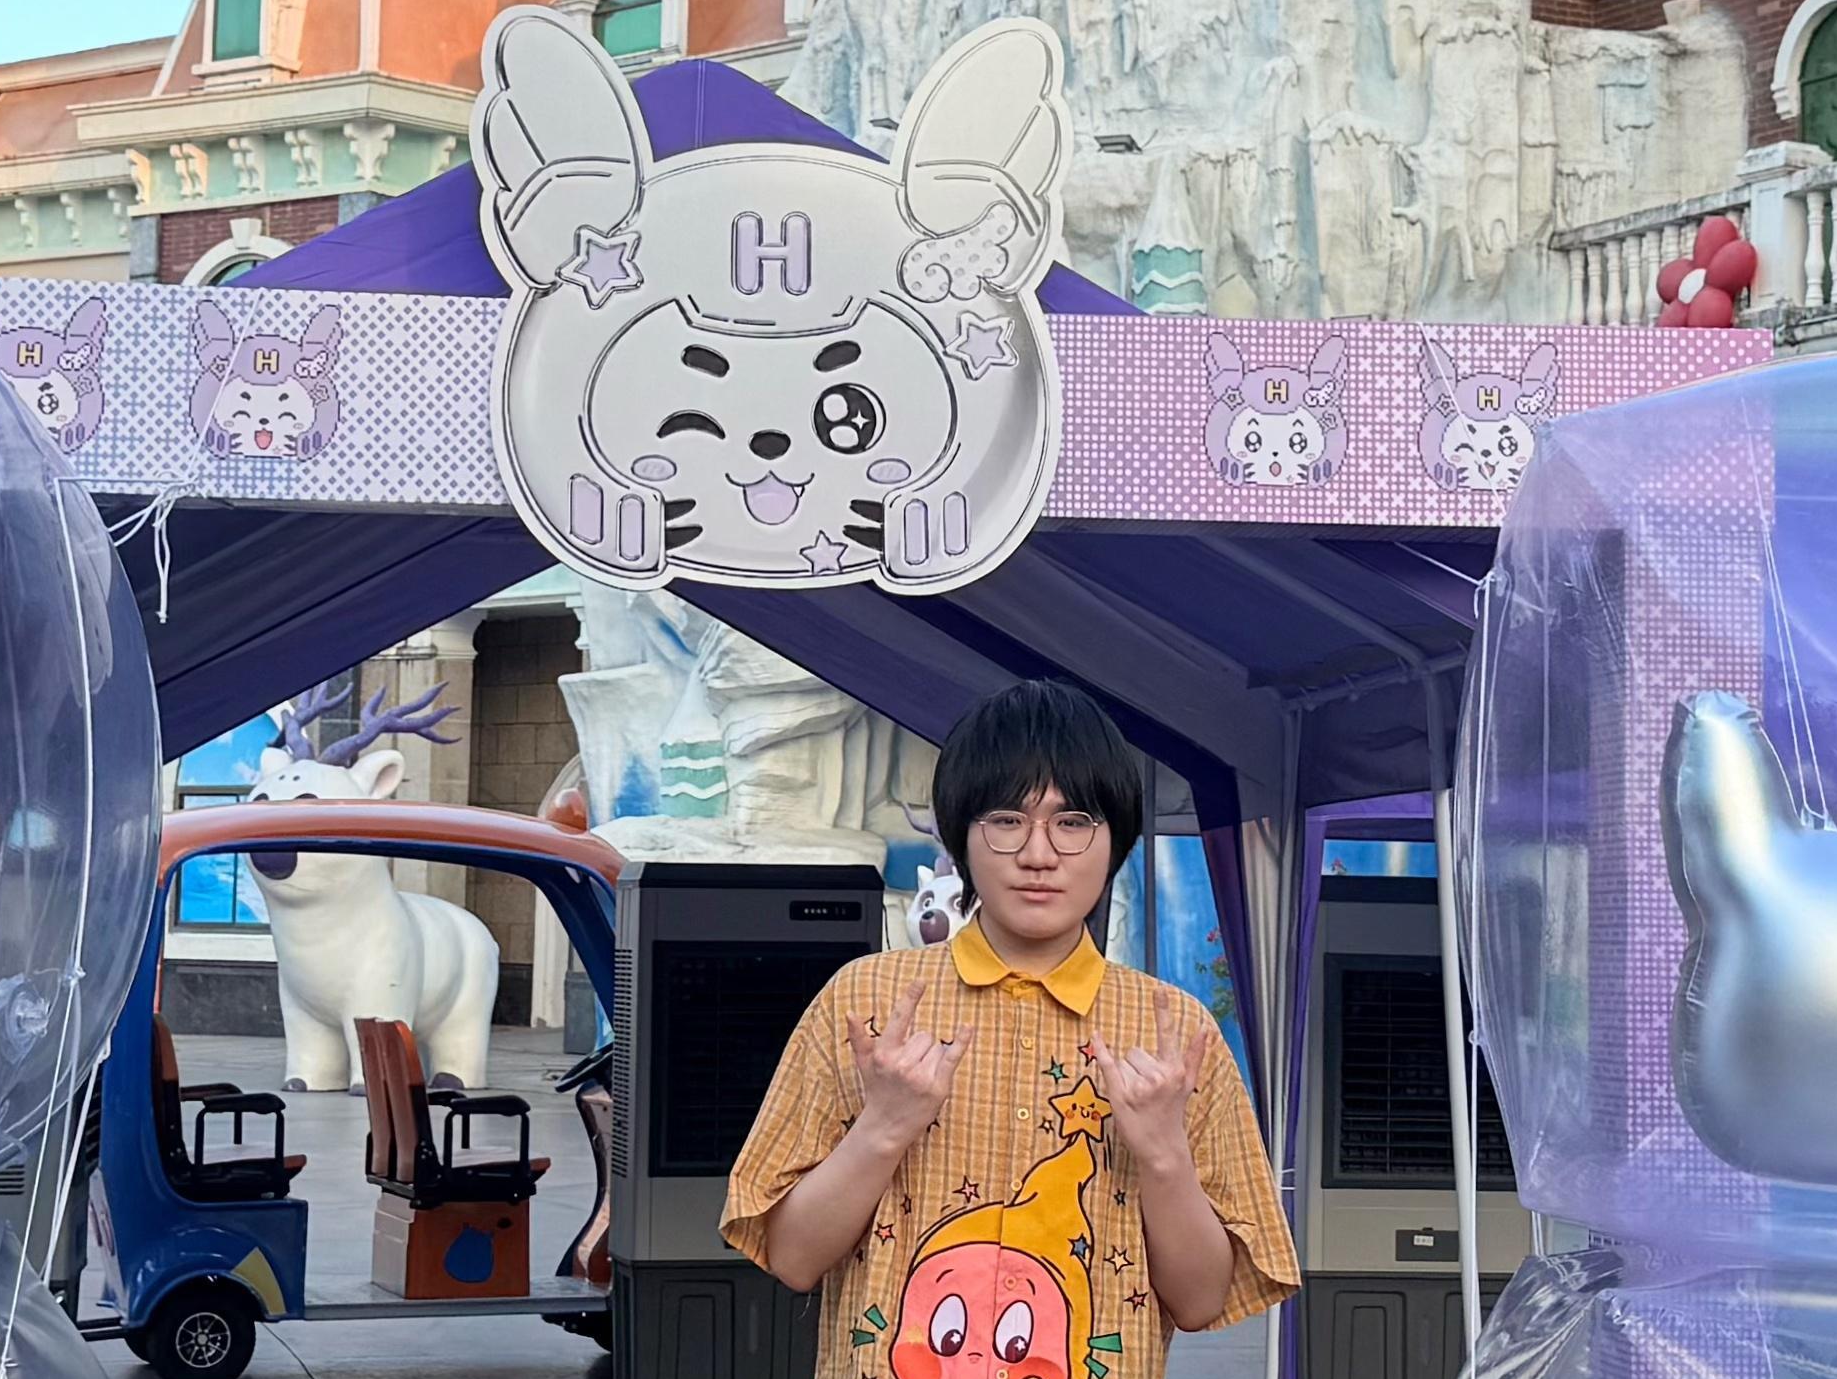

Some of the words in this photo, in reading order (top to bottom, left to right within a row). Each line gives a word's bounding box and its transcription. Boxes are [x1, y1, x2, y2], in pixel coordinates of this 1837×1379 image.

[731, 210, 812, 296] H
[16, 341, 43, 367] H
[253, 349, 280, 375] H
[1264, 379, 1290, 404] H
[1477, 386, 1502, 411] H
